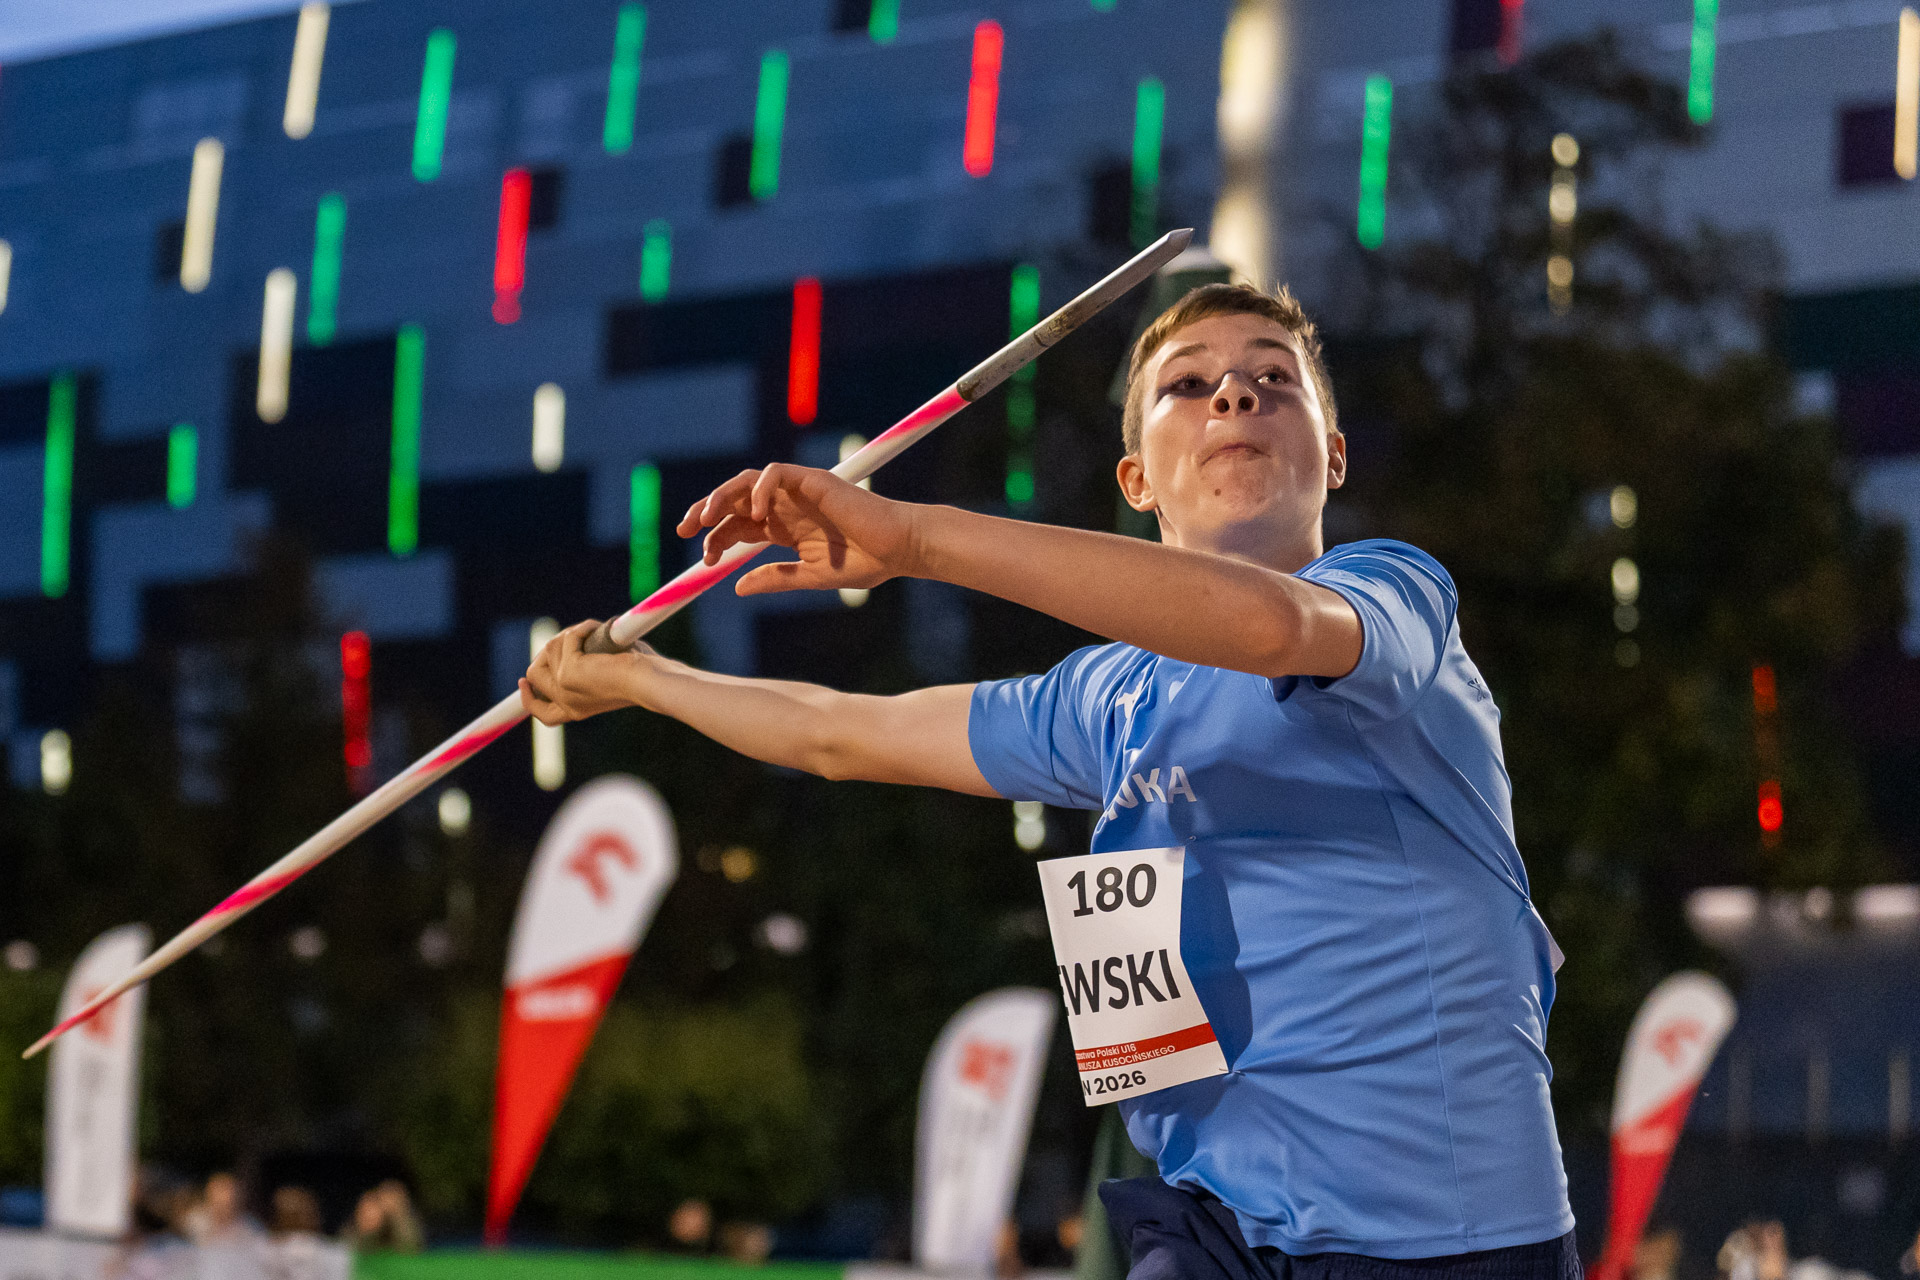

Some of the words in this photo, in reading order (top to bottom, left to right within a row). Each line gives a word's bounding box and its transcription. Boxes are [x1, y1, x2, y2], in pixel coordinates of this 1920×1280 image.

[1067, 863, 1157, 917] 180
[1058, 949, 1181, 1016] WSKI
[1096, 1046, 1120, 1059] Polski
[1120, 1043, 1137, 1054] U16
[1102, 1045, 1176, 1069] KUSOCIŃSKIEGO
[1093, 1070, 1147, 1095] 2026
